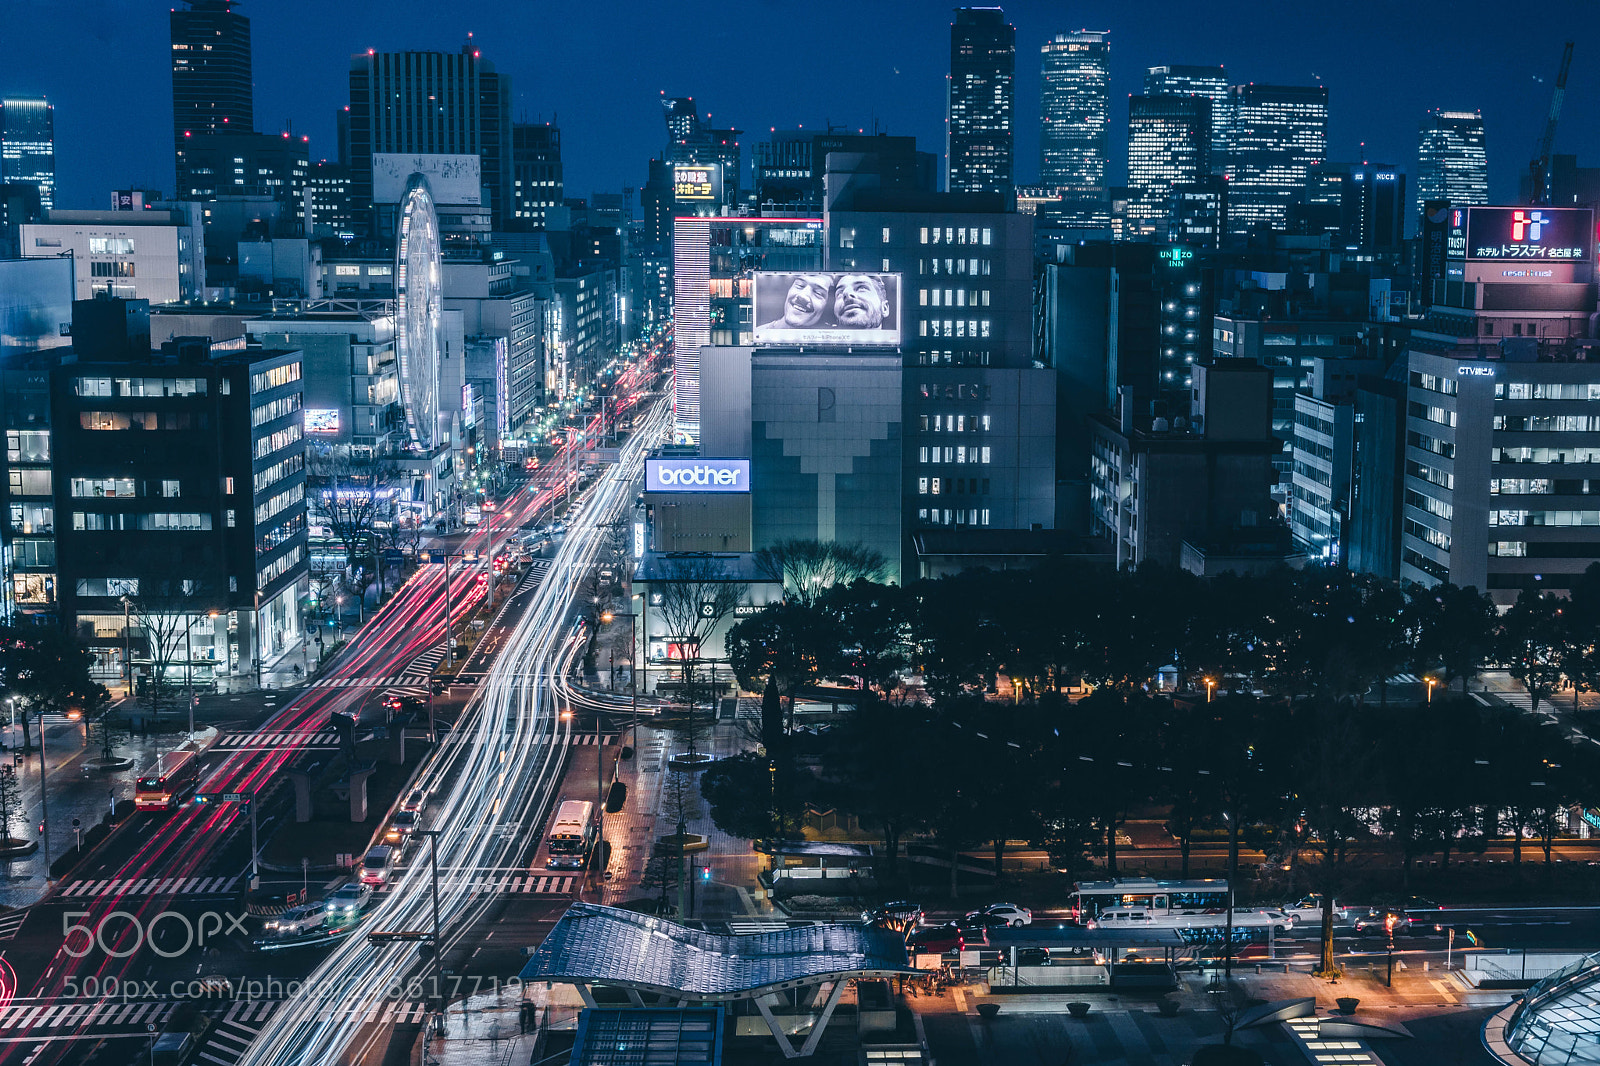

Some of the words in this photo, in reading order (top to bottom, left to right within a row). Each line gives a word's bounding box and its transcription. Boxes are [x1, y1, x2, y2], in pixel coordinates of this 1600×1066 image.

[1448, 237, 1466, 249] TRUSTY
[1160, 250, 1193, 259] UNIZO
[1502, 244, 1547, 257] トラスティ
[1548, 248, 1572, 258] 名古屋
[658, 465, 741, 485] brother
[735, 606, 754, 615] LOUIS
